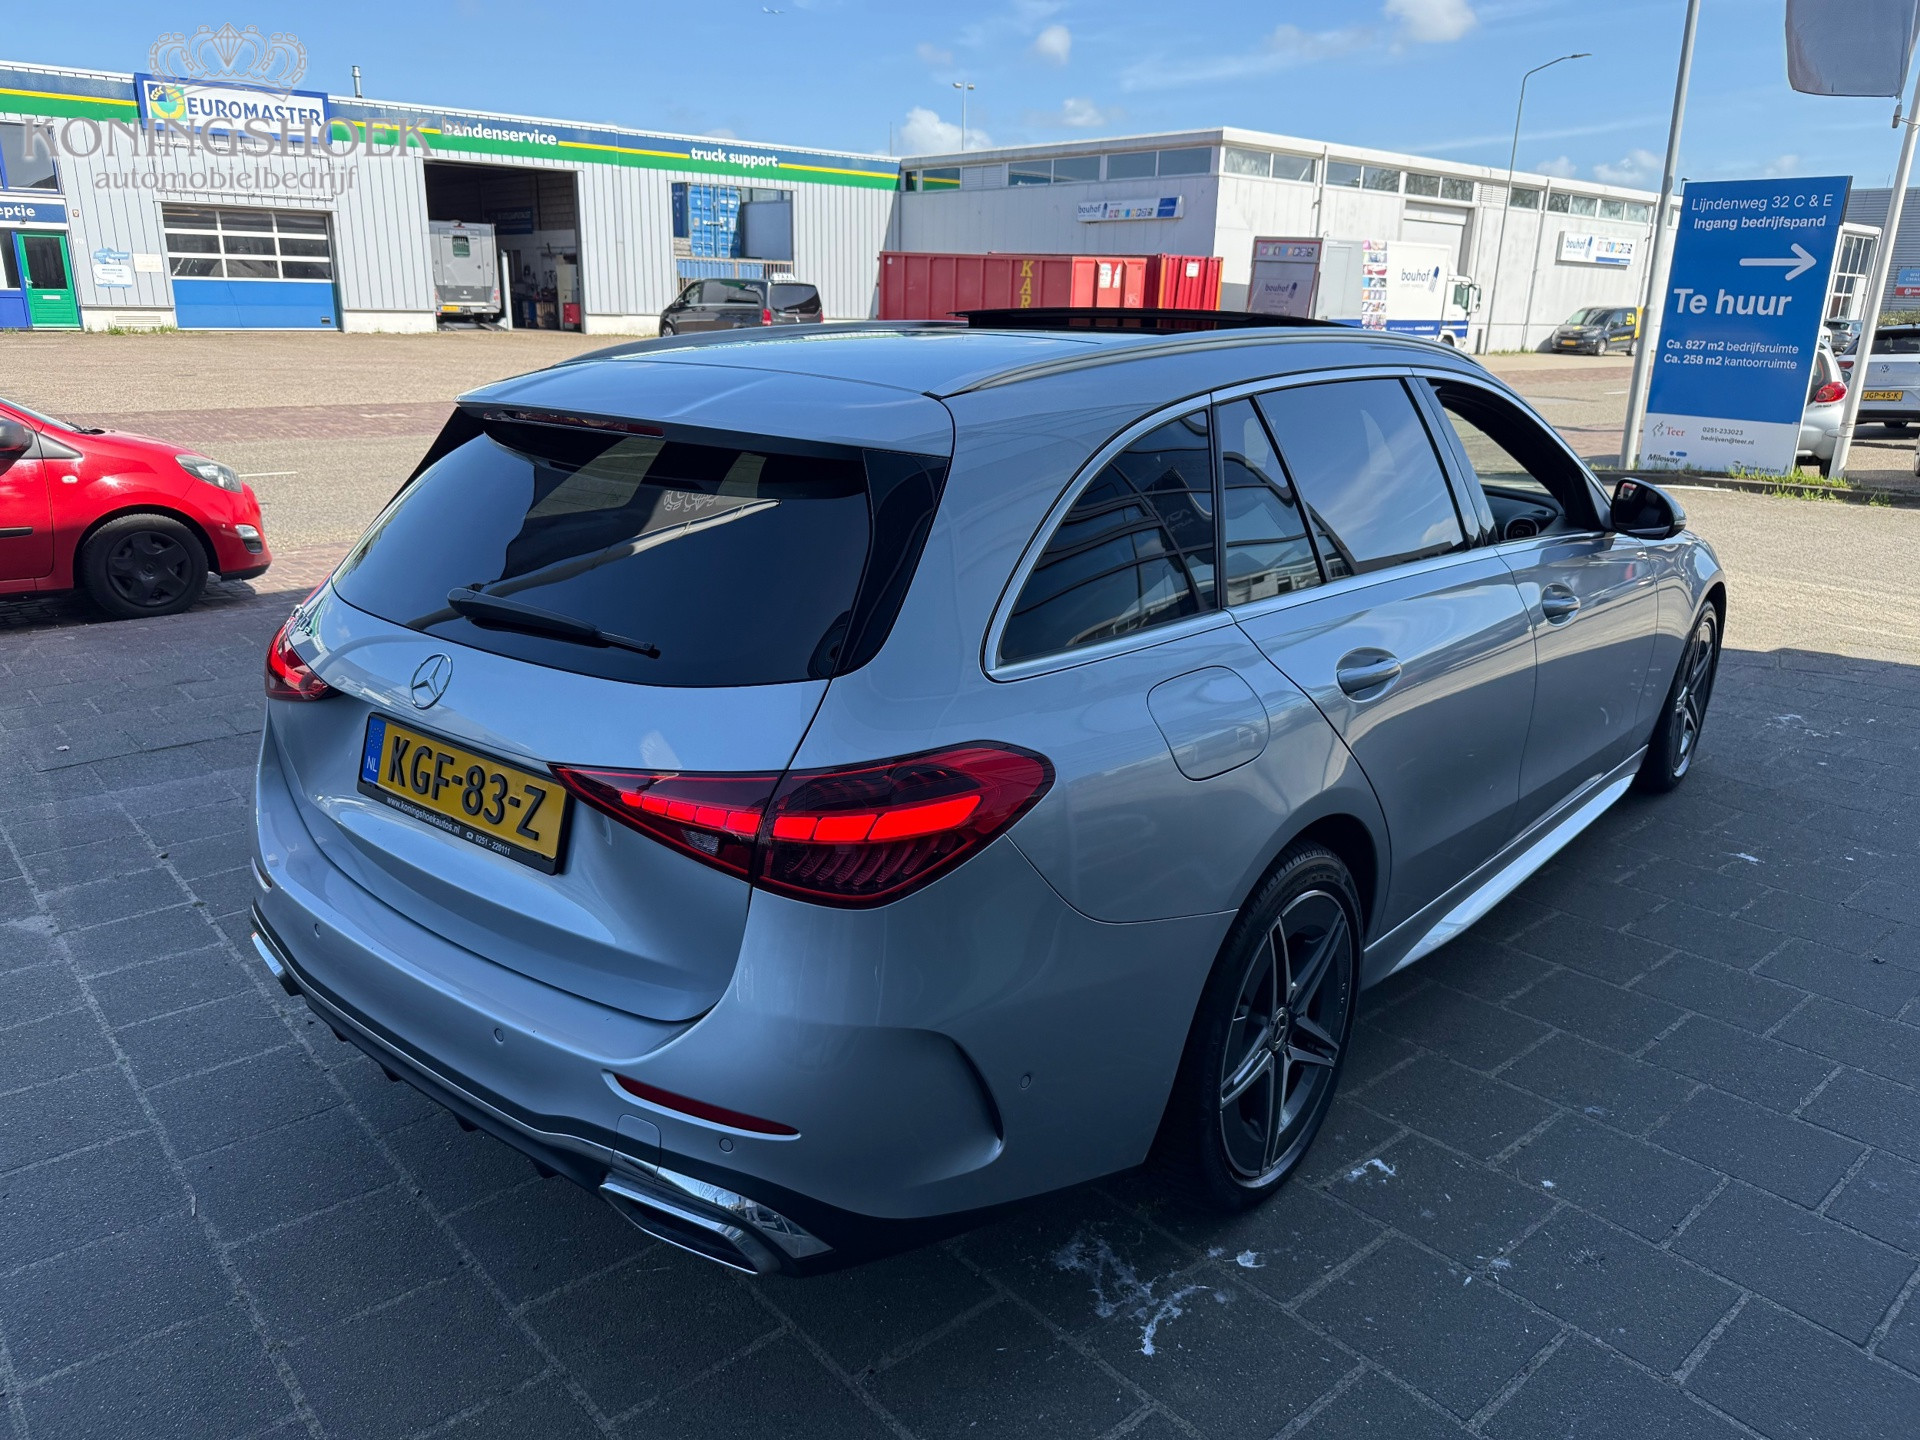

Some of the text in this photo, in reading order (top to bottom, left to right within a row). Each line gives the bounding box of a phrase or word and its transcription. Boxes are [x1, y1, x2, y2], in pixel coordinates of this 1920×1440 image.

[186, 96, 322, 127] EUROMASTER
[442, 123, 557, 145] bandenservice
[691, 147, 778, 169] truck support
[1691, 193, 1833, 213] Lijndenweg 32 C & E
[1693, 215, 1827, 232] Ingang bedrijfspand
[1400, 268, 1431, 281] bouhof
[1673, 288, 1793, 316] Te huur
[1666, 339, 1799, 355] Ca. 827 m2 bedrijfsruimte
[1663, 353, 1798, 370] Ca. 258 m2 kantoorruimte
[1665, 426, 1686, 437] Teer
[1702, 426, 1743, 436] 0251-233023
[1700, 435, 1755, 446] bedrijven@teer.nl
[1647, 453, 1680, 464] Mileway
[366, 755, 378, 773] NL
[388, 735, 547, 841] KGF-83-Z
[386, 796, 461, 834] www.koningshoekautos.nl
[475, 834, 489, 846] 0251
